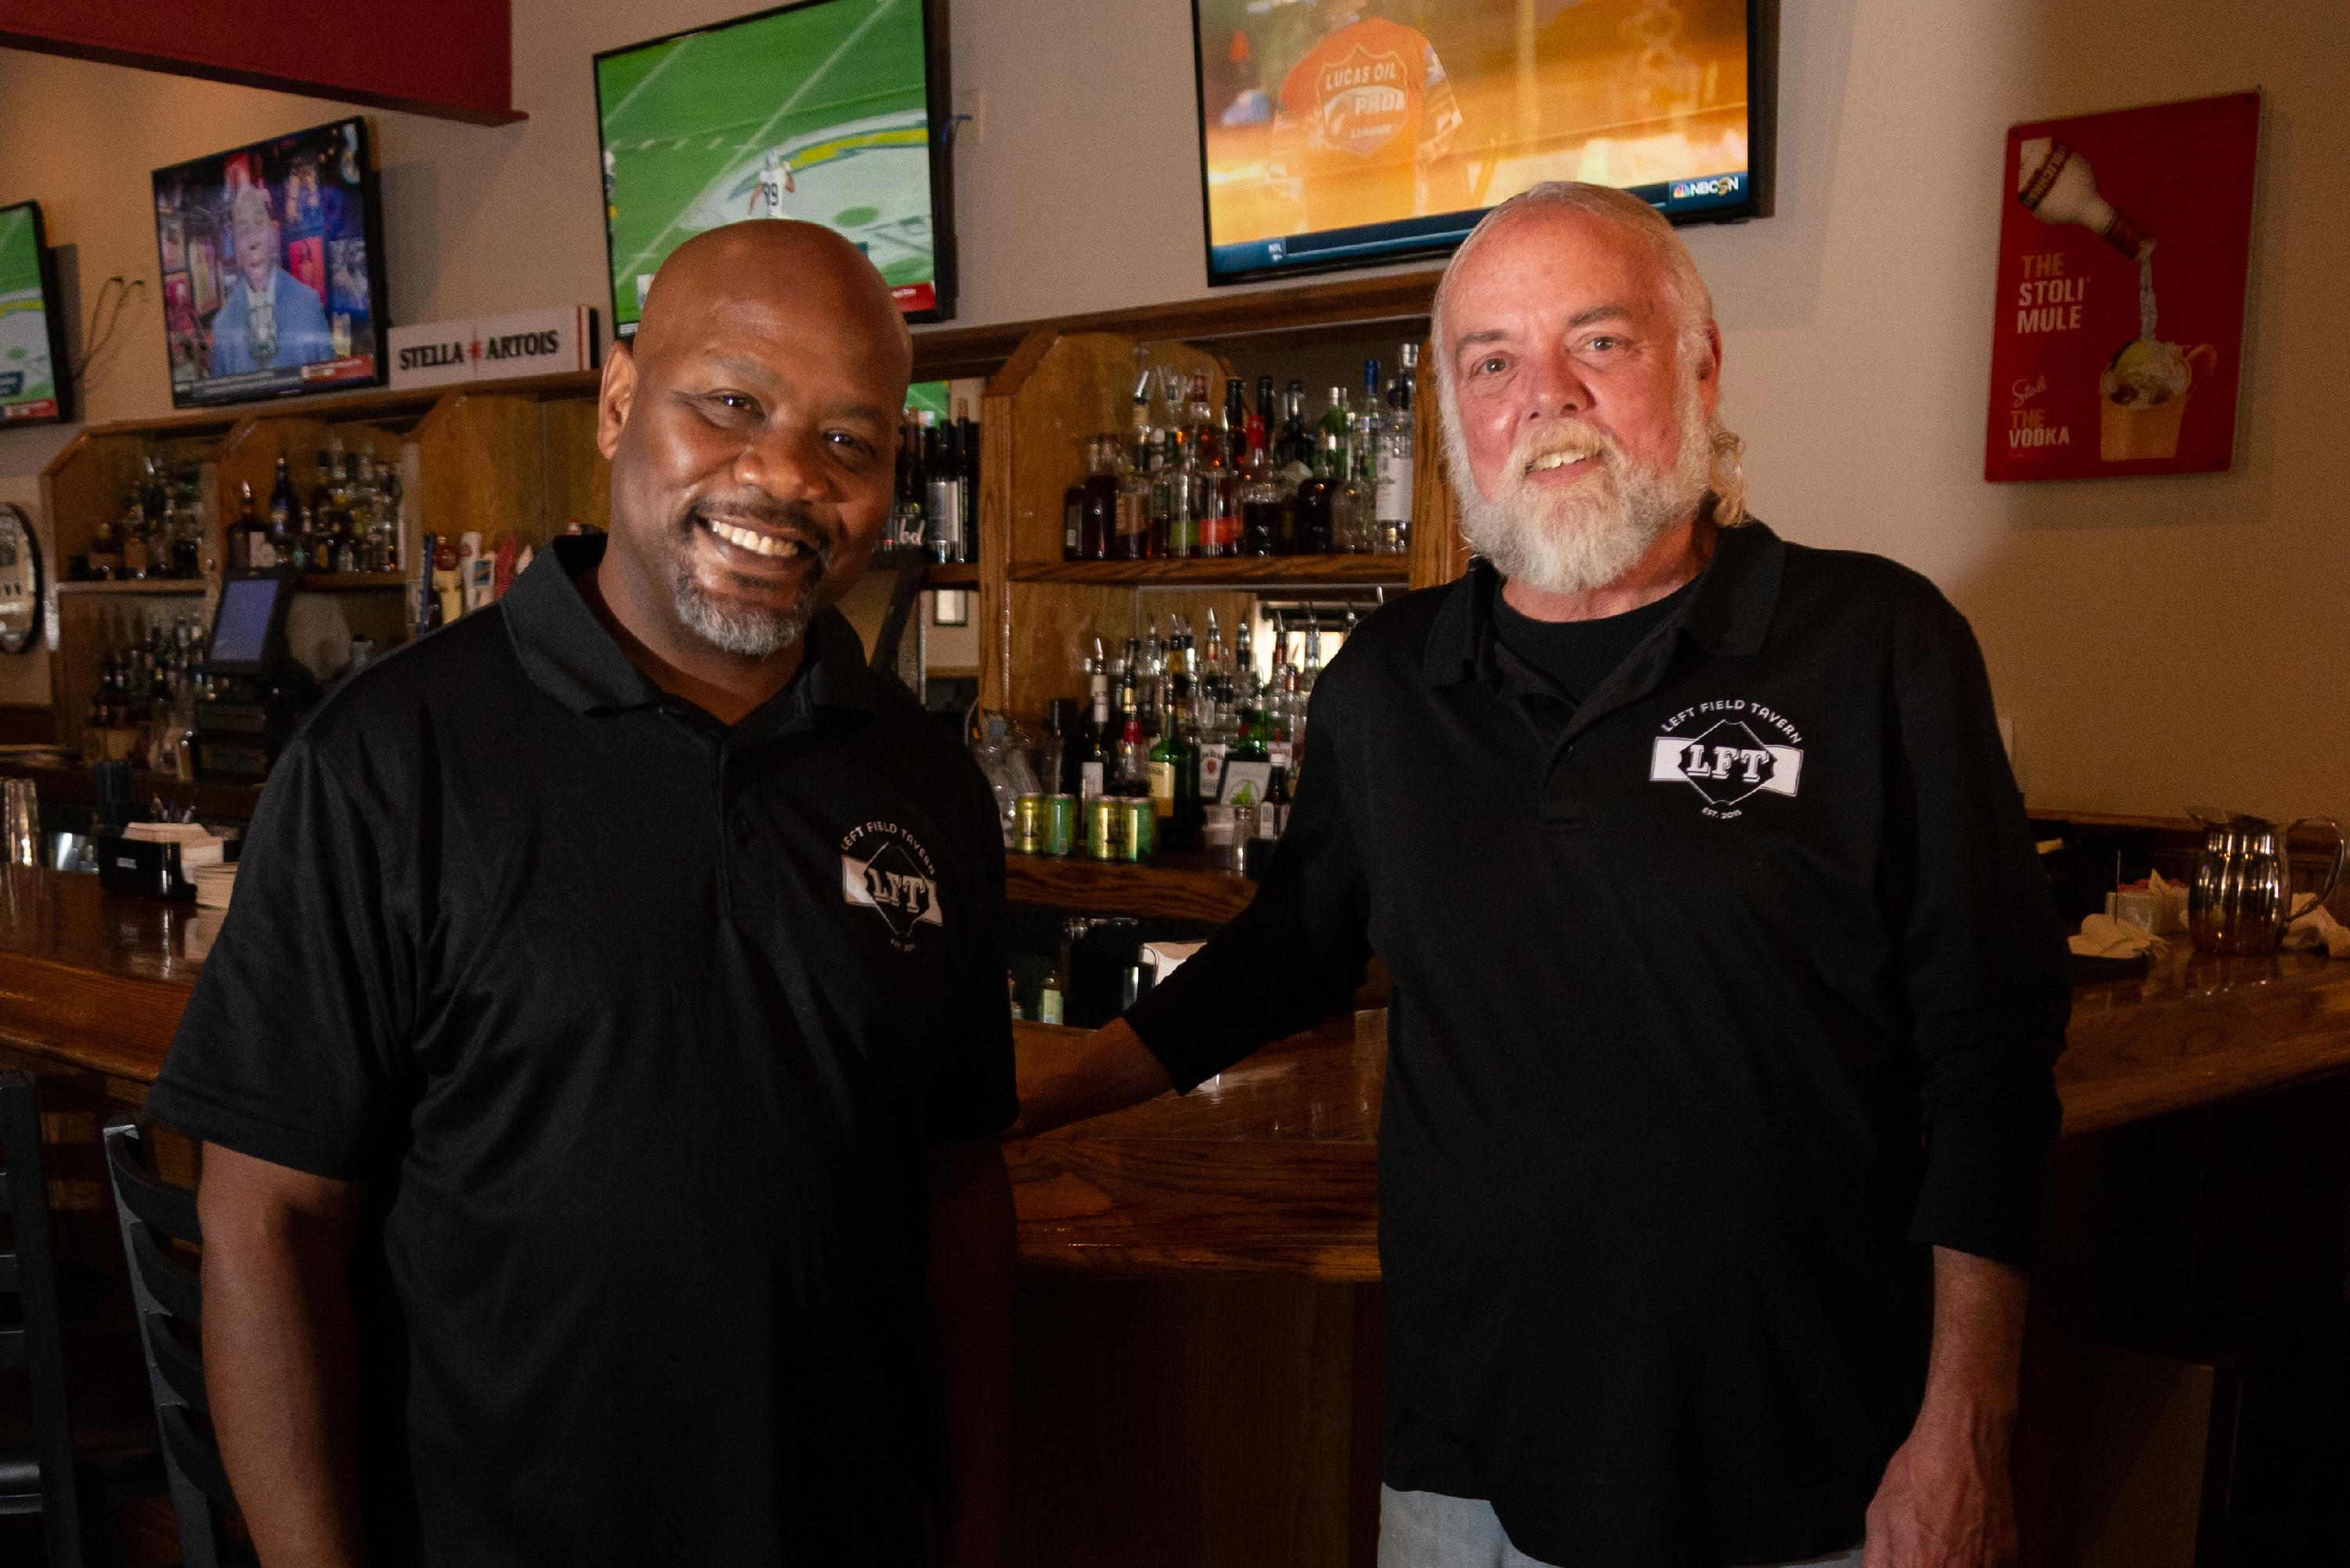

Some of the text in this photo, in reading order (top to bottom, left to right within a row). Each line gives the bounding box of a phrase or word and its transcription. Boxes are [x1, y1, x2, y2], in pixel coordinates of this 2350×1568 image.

[1325, 62, 1396, 91] LUCAS OIL
[2021, 253, 2064, 279] THE
[2017, 305, 2083, 334] MULE
[400, 341, 465, 370] STELLA
[485, 329, 560, 359] ARTOIS
[2010, 409, 2044, 430] THE
[2008, 426, 2070, 450] VODKA
[1660, 699, 1802, 744] LEFT FIELD TAVERN
[1686, 744, 1770, 783] LFT
[1701, 807, 1719, 817] EST.
[841, 821, 936, 876] LEFT FIELD TAVERN
[866, 867, 926, 914] LFT
